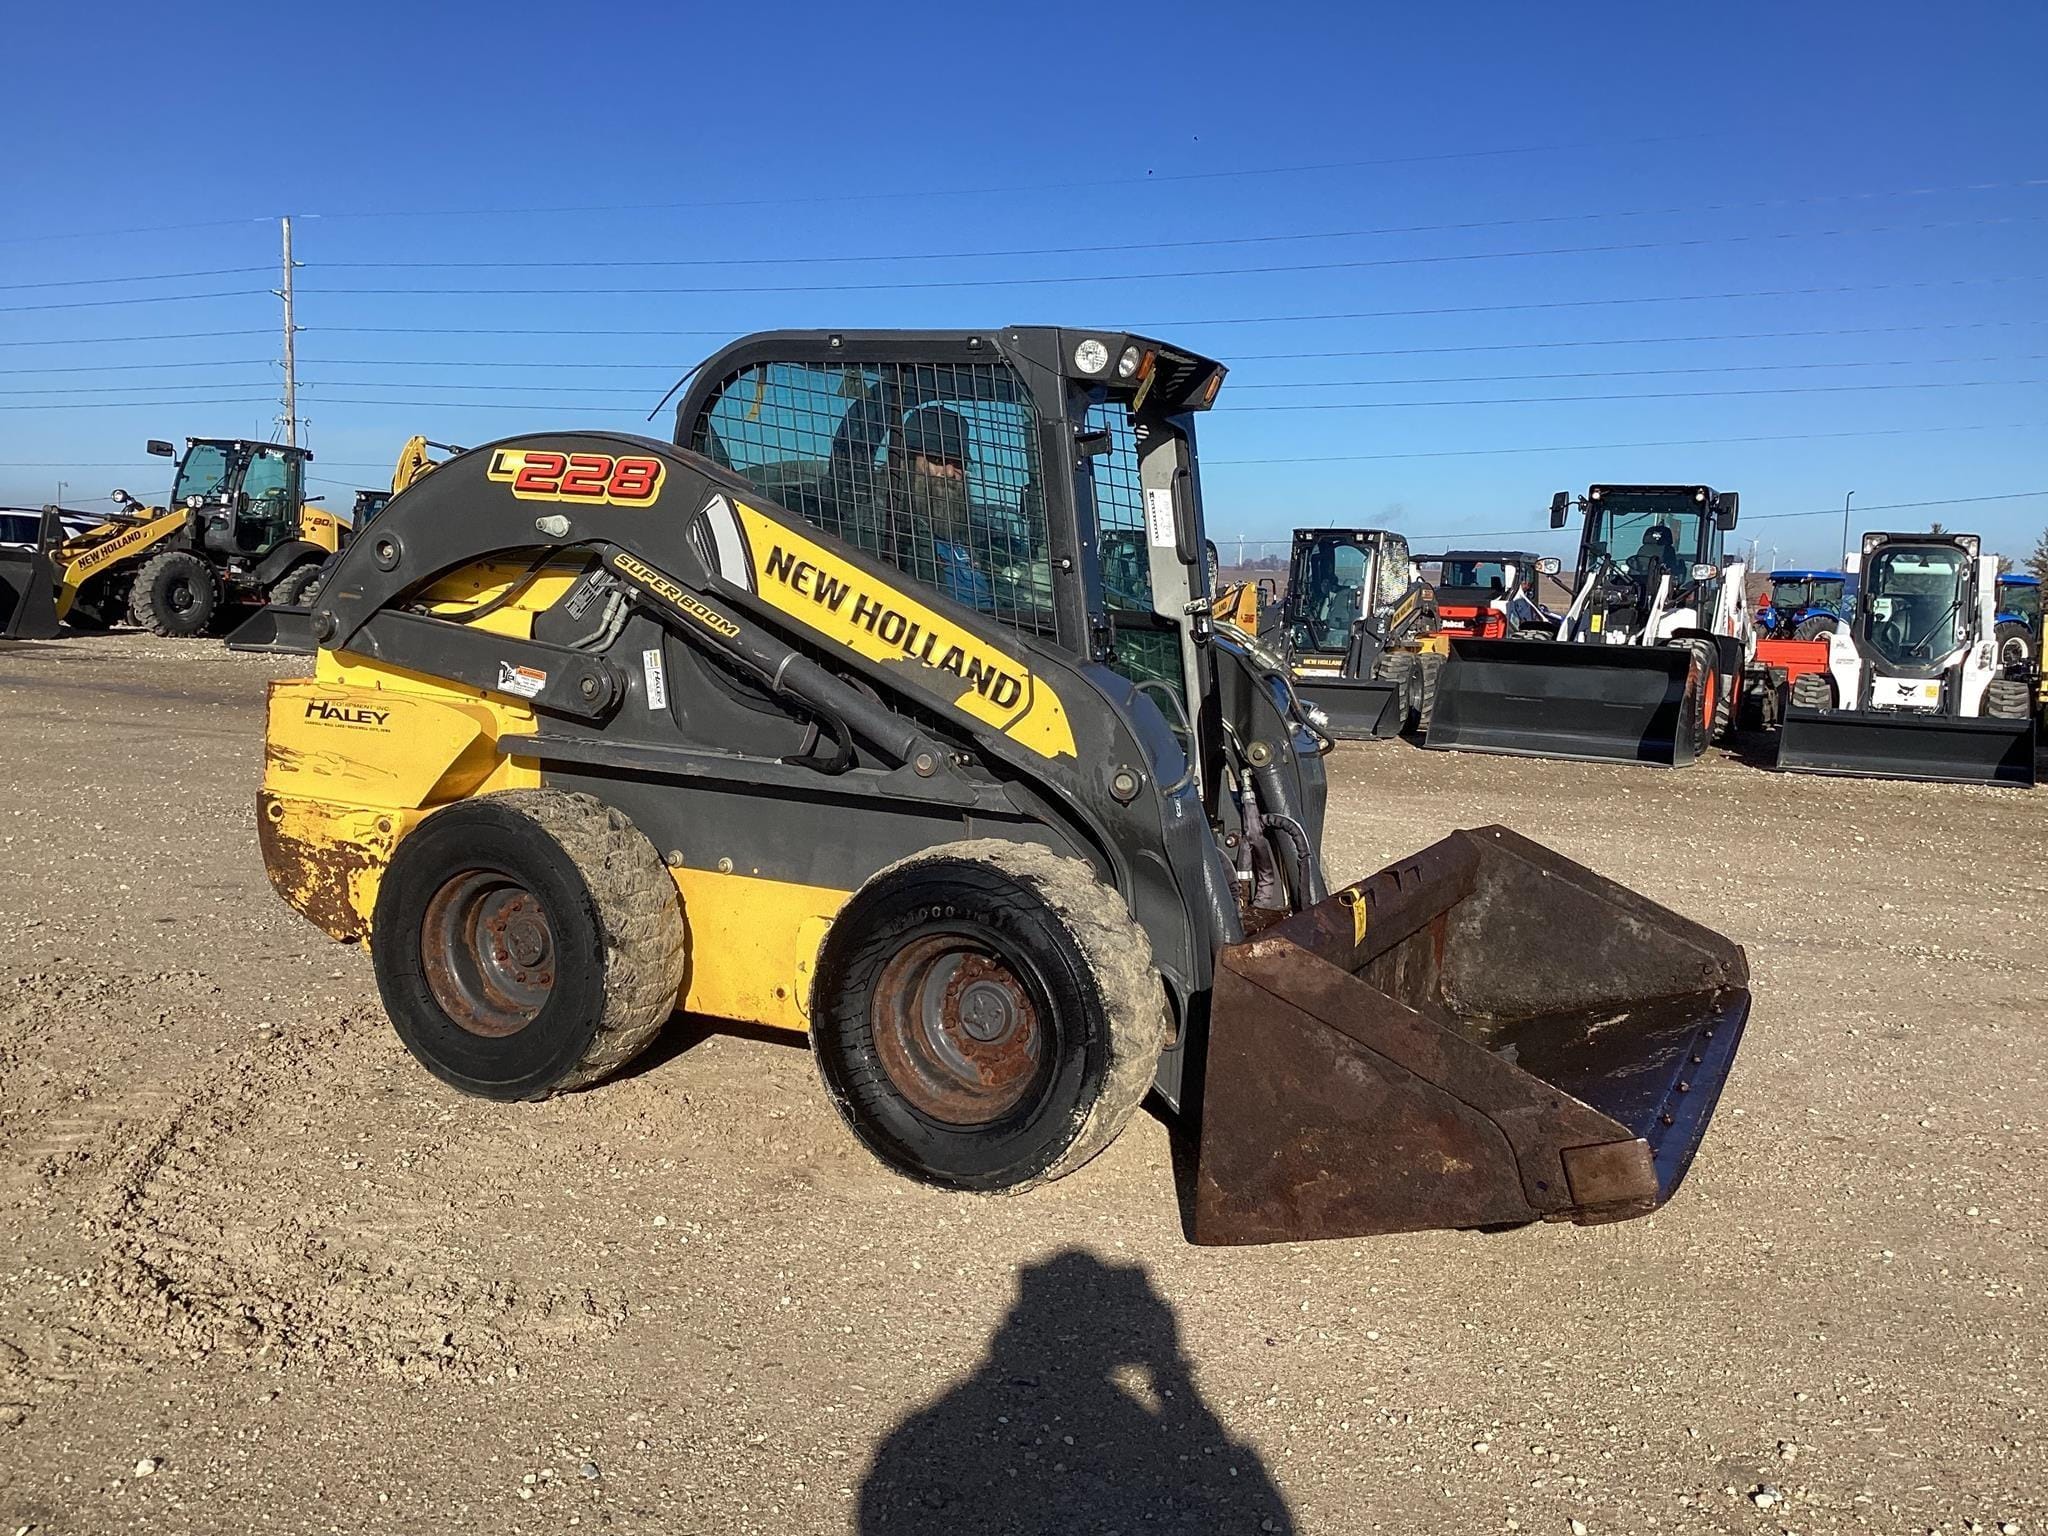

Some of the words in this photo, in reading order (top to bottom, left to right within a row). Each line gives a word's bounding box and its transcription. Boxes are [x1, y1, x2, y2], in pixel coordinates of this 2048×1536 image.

[491, 452, 661, 499] L228
[78, 551, 99, 569] NEW
[101, 530, 141, 557] HOLLAND
[764, 544, 851, 613] NEW
[850, 594, 1022, 711] HOLLAND
[305, 700, 390, 725] HALEY
